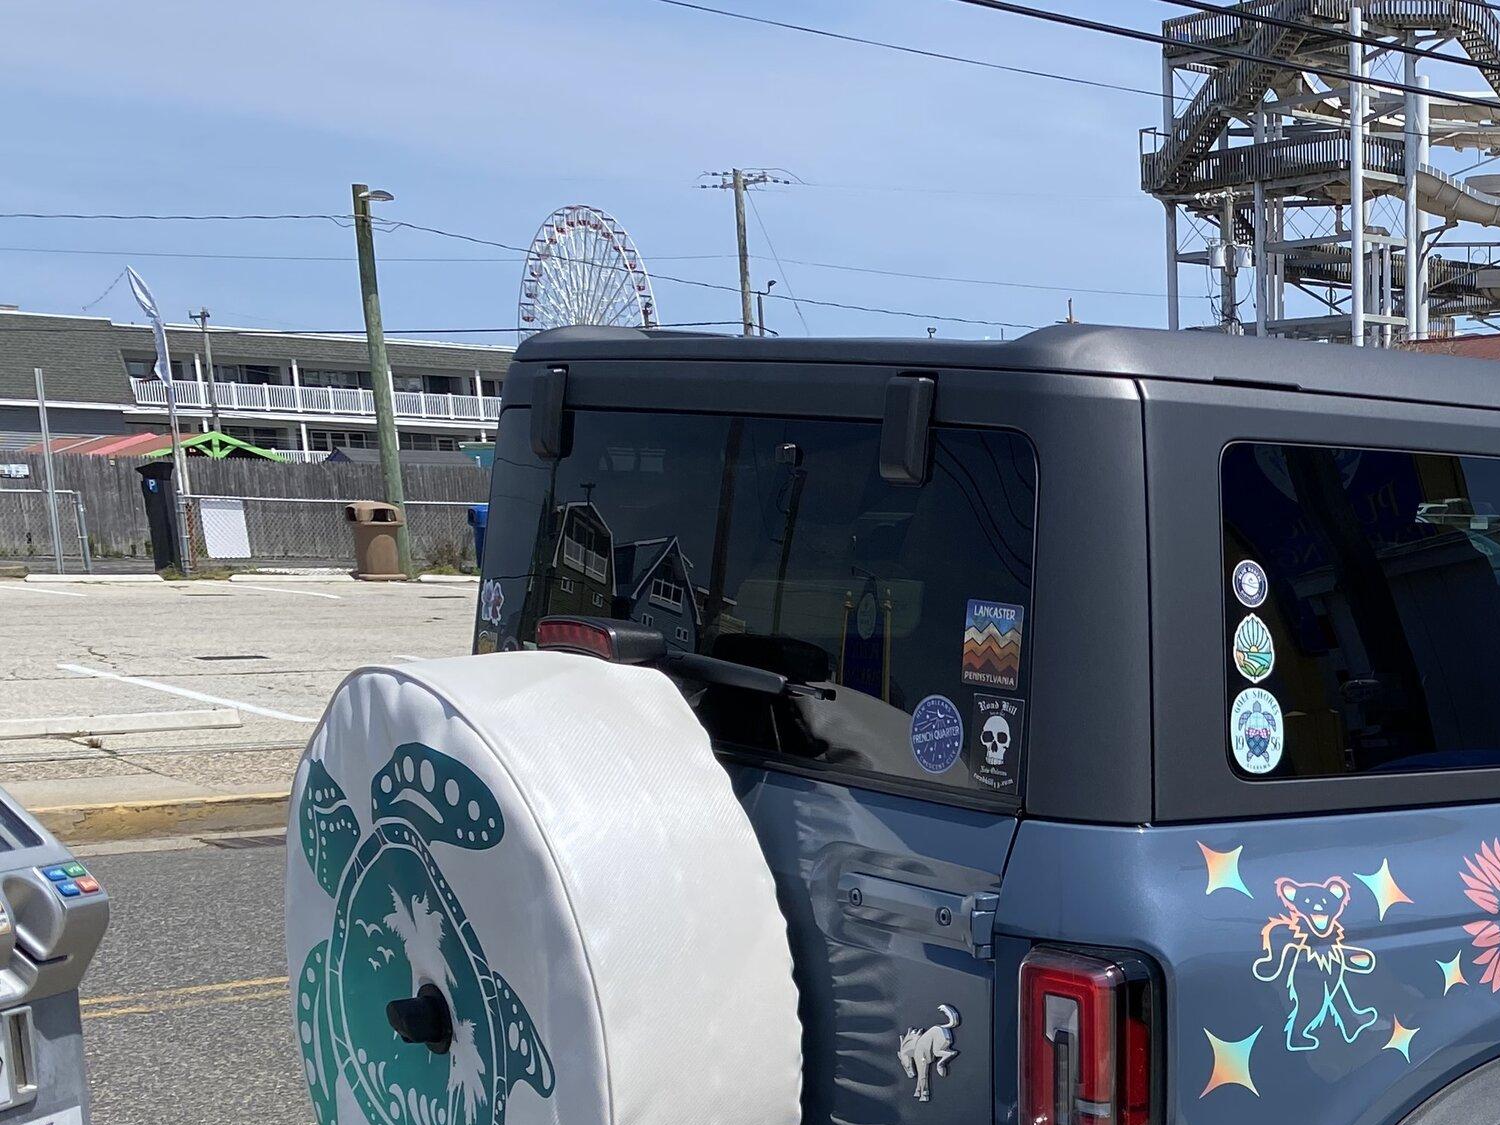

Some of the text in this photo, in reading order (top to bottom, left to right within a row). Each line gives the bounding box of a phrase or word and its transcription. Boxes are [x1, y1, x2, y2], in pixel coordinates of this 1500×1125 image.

[149, 479, 156, 490] P
[974, 605, 1016, 620] LANCASTER
[964, 671, 1015, 686] PENNSYLVANIA
[927, 700, 951, 713] ORLEANS
[978, 701, 1018, 715] Road Kill
[1234, 690, 1279, 715] GULF SHORES
[912, 726, 959, 744] FRENCH QUARTER
[1235, 735, 1281, 751] 19 56
